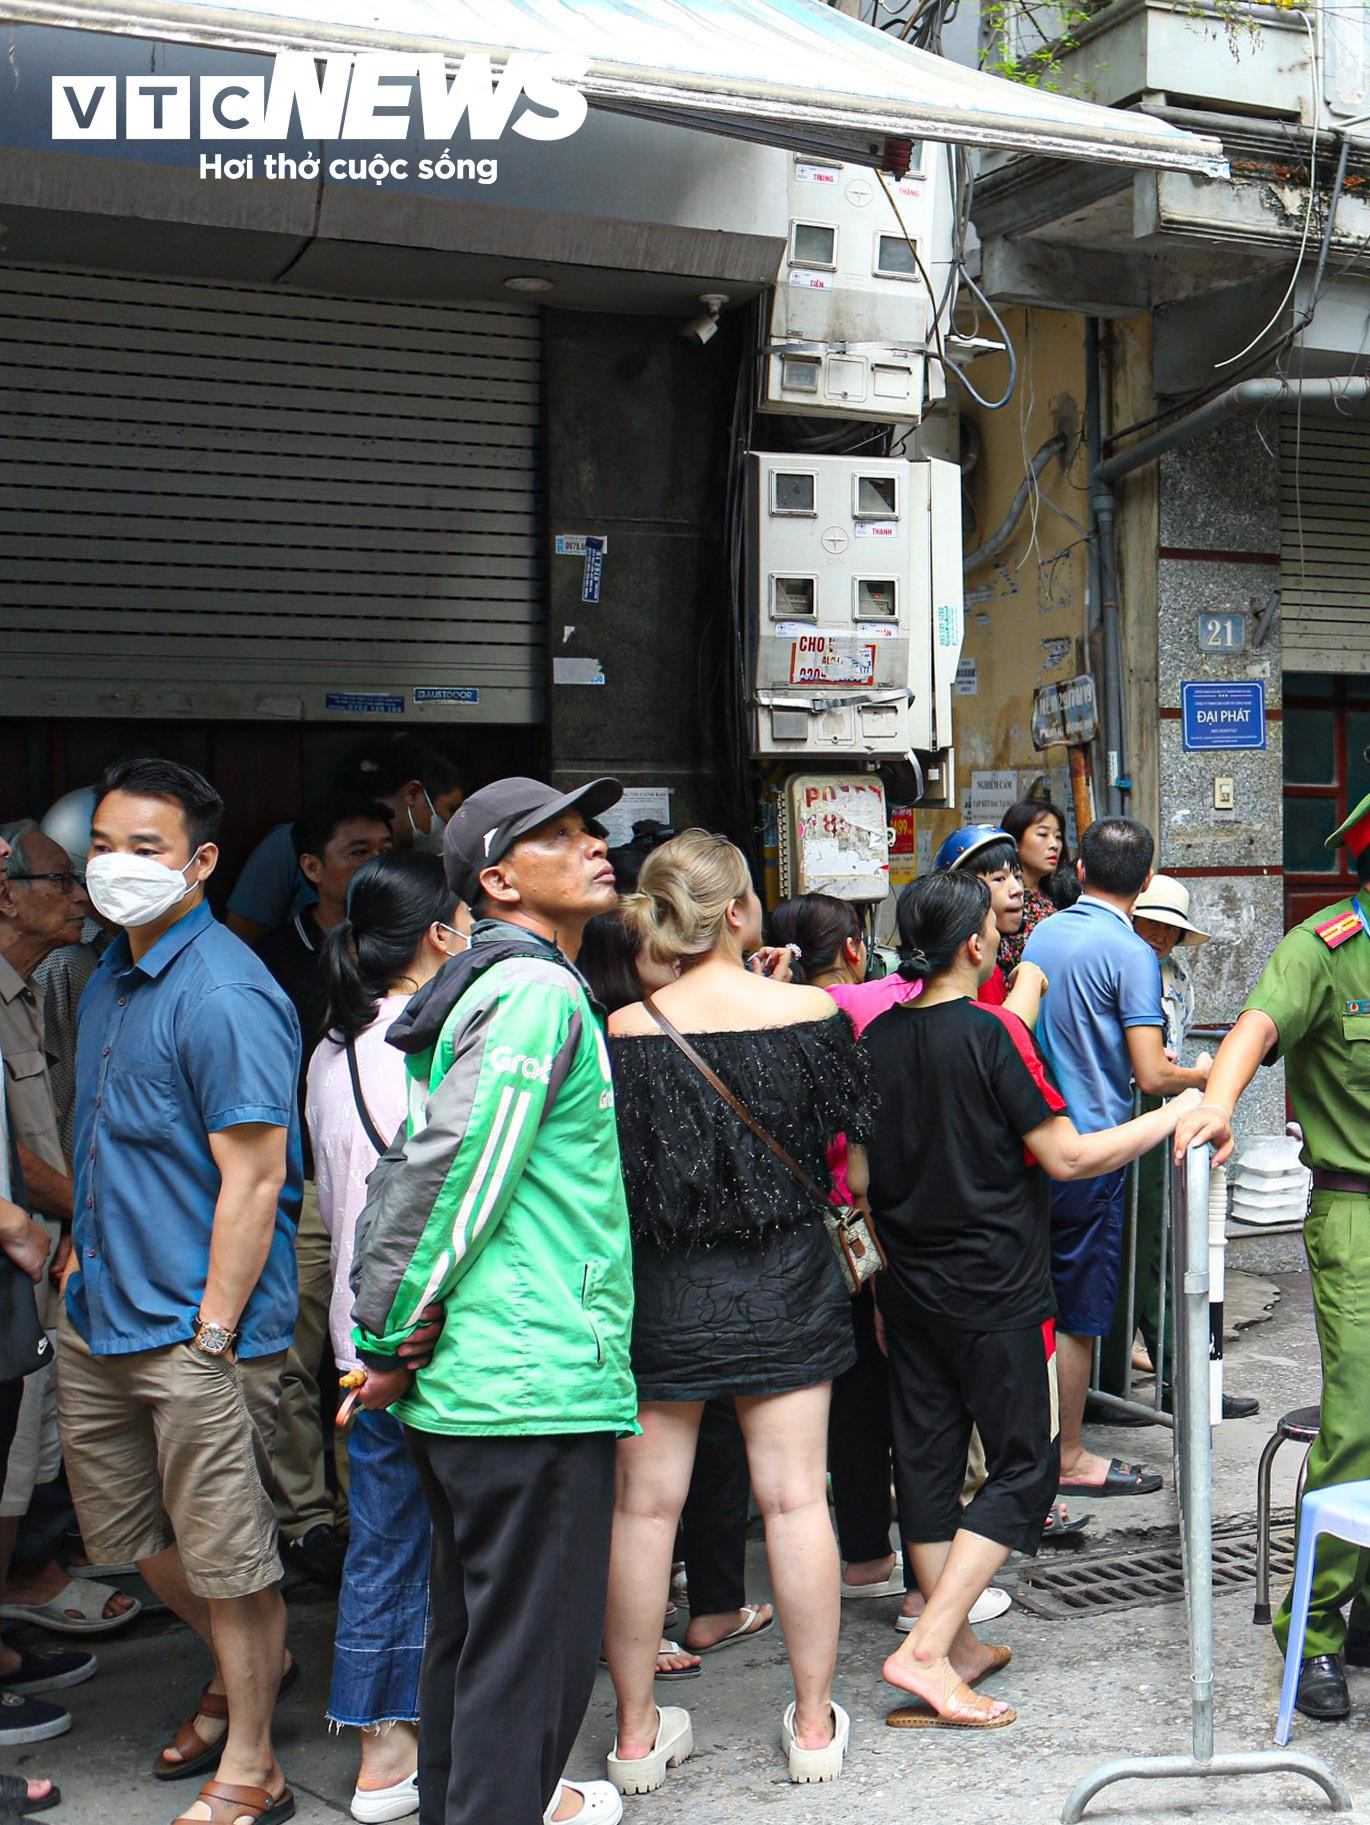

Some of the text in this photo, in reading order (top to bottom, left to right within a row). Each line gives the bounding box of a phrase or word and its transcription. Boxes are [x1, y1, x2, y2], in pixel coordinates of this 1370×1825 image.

[1207, 619, 1234, 646] 21
[799, 636, 825, 652] CHO
[424, 690, 473, 699] AUSTDOOR
[1196, 707, 1251, 726] ĐẠI PHÁT
